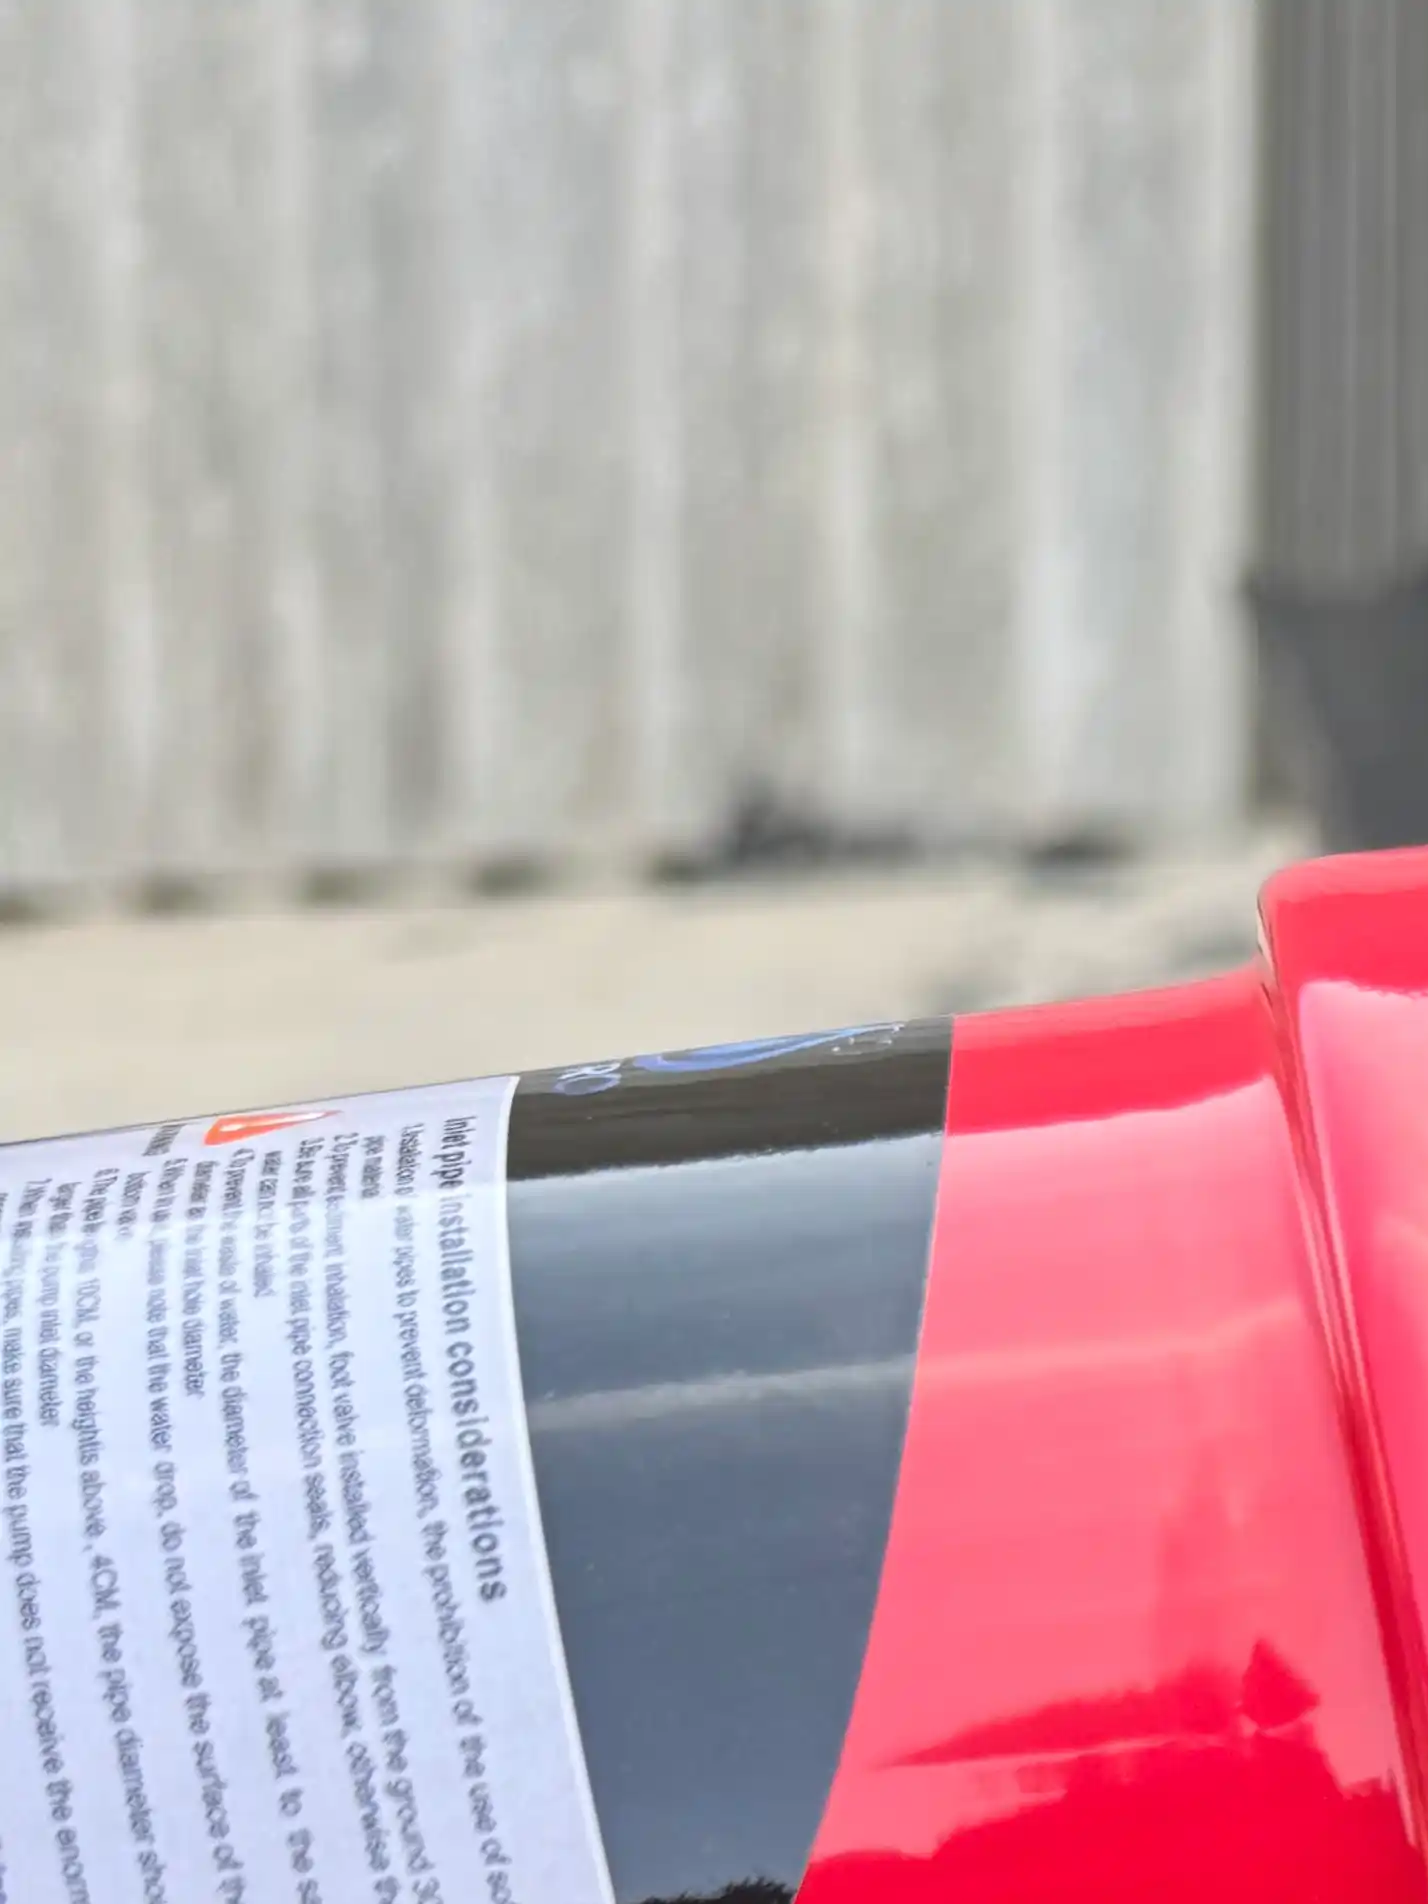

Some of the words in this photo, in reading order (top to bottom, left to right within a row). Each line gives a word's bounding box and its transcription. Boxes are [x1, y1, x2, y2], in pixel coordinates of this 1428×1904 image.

[441, 1116, 476, 1150] Inlet
[431, 1151, 472, 1189] pipe
[392, 1245, 415, 1288] pipes
[438, 1195, 476, 1335] installation
[146, 1288, 168, 1323] note
[181, 1280, 205, 1316] hole
[396, 1289, 420, 1308] to
[39, 1309, 62, 1345] inlet
[146, 1326, 169, 1361] that
[285, 1317, 312, 1356] pipe
[393, 1310, 427, 1381] prevent
[2, 1327, 24, 1375] make
[74, 1355, 99, 1386] the
[181, 1319, 207, 1398] diameter
[220, 1352, 243, 1383] the
[328, 1351, 355, 1390] foot
[2, 1378, 22, 1420] sure
[38, 1347, 62, 1427] diameter
[147, 1363, 171, 1394] the
[71, 1387, 102, 1467] heightis
[150, 1397, 172, 1452] water
[221, 1386, 248, 1474] diameter
[292, 1359, 324, 1469] connection
[332, 1393, 359, 1446] valve
[2, 1422, 28, 1463] that
[5, 1465, 30, 1500] the
[229, 1480, 259, 1502] of
[446, 1342, 507, 1603] considerations
[338, 1451, 375, 1546] installed
[1, 1504, 33, 1568] pump
[159, 1521, 186, 1553] do
[233, 1511, 261, 1550] the
[421, 1520, 448, 1561] the
[164, 1557, 192, 1595] not
[238, 1553, 270, 1606] inlet
[313, 1543, 348, 1651] reducing
[15, 1572, 41, 1631] does
[351, 1548, 390, 1655] vertically
[97, 1622, 123, 1664] the
[168, 1598, 203, 1688] expose
[241, 1615, 277, 1671] pipe
[422, 1563, 470, 1696] prohibition
[23, 1636, 52, 1677] not
[97, 1668, 132, 1724] pipe
[256, 1676, 284, 1703] at
[371, 1665, 399, 1726] from
[30, 1681, 64, 1775] receive
[184, 1692, 212, 1736] the
[451, 1699, 483, 1726] of
[265, 1712, 300, 1780] least
[381, 1728, 409, 1773] the
[458, 1734, 486, 1778] the
[45, 1778, 73, 1822] the
[114, 1729, 155, 1845] diameter
[192, 1740, 230, 1839] surface
[279, 1788, 303, 1818] to
[345, 1742, 390, 1872] otherwise
[468, 1782, 497, 1834] use
[384, 1777, 435, 1875] ground
[212, 1844, 244, 1872] of
[286, 1828, 314, 1874] the
[480, 1838, 512, 1866] of
